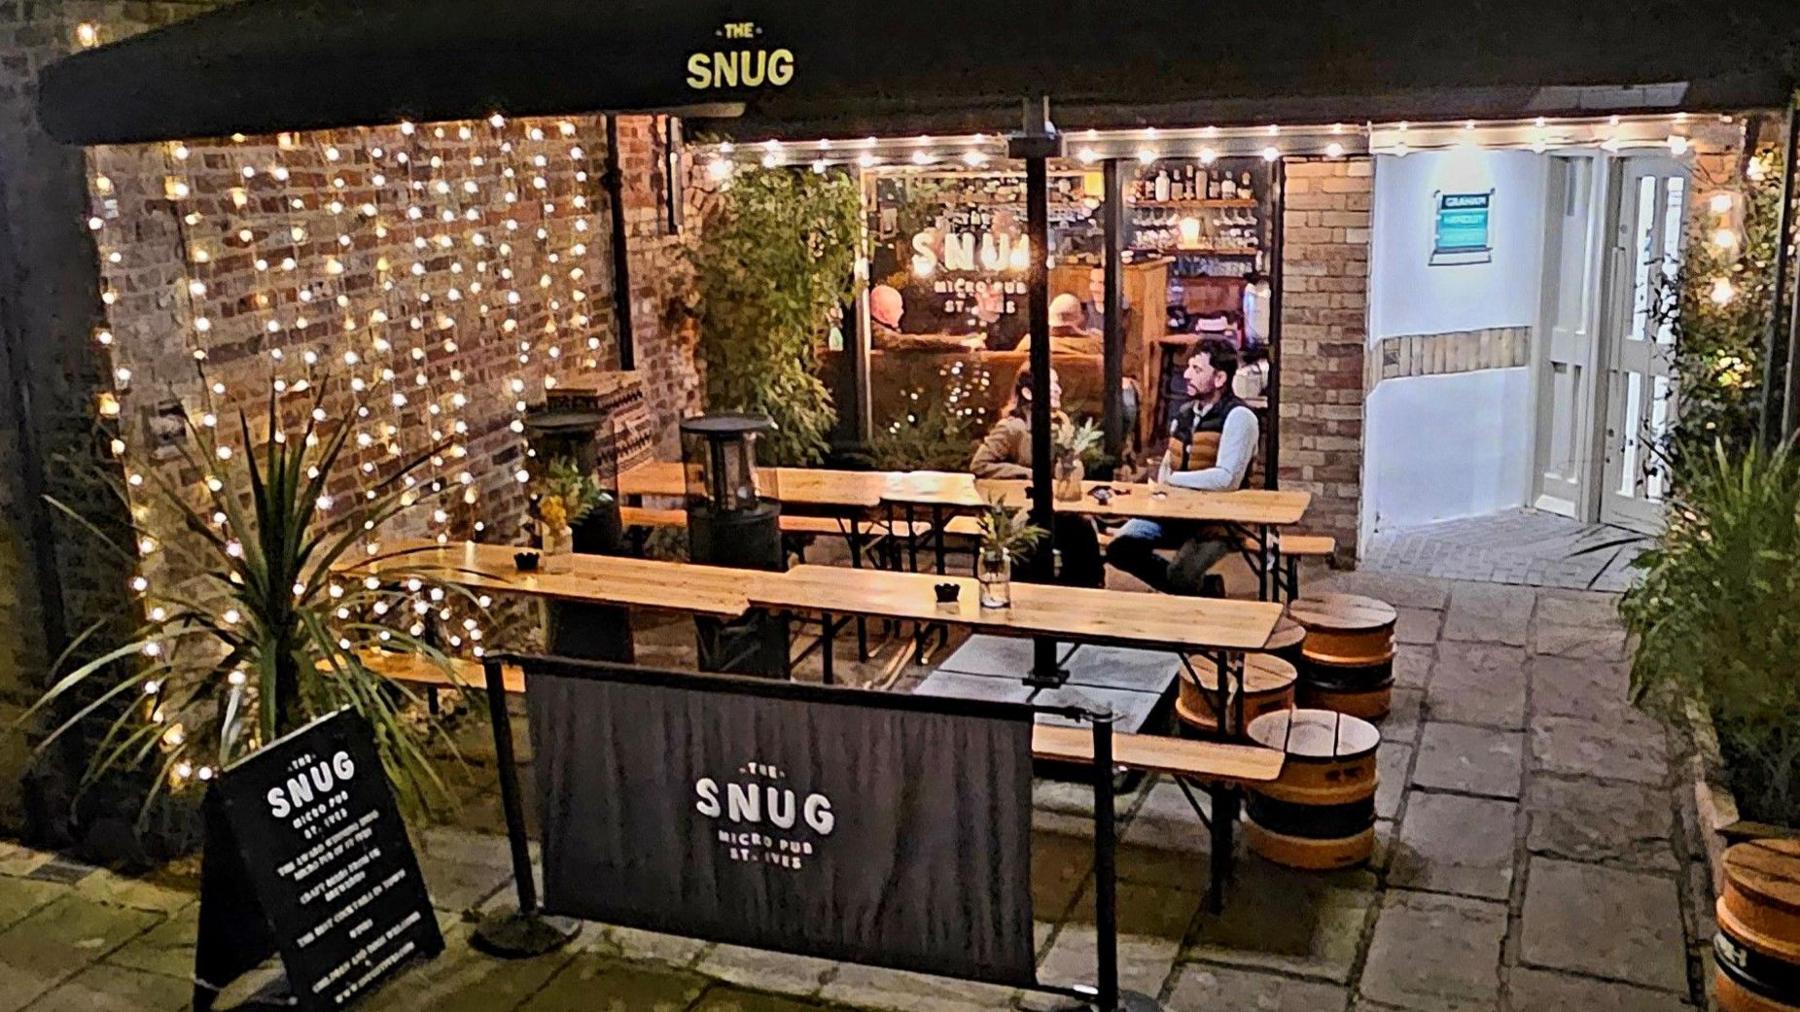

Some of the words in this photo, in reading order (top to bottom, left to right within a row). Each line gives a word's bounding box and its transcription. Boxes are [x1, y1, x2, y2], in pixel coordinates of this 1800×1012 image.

[724, 22, 754, 39] THE
[686, 48, 794, 90] SNUG
[267, 750, 355, 818] SNUG
[748, 762, 777, 779] THE
[293, 803, 327, 829] MICRO
[328, 790, 348, 808] PUB
[696, 777, 834, 835] SNUG
[718, 830, 772, 848] MICRO
[779, 839, 813, 854] PUB
[764, 851, 802, 870] IVES
